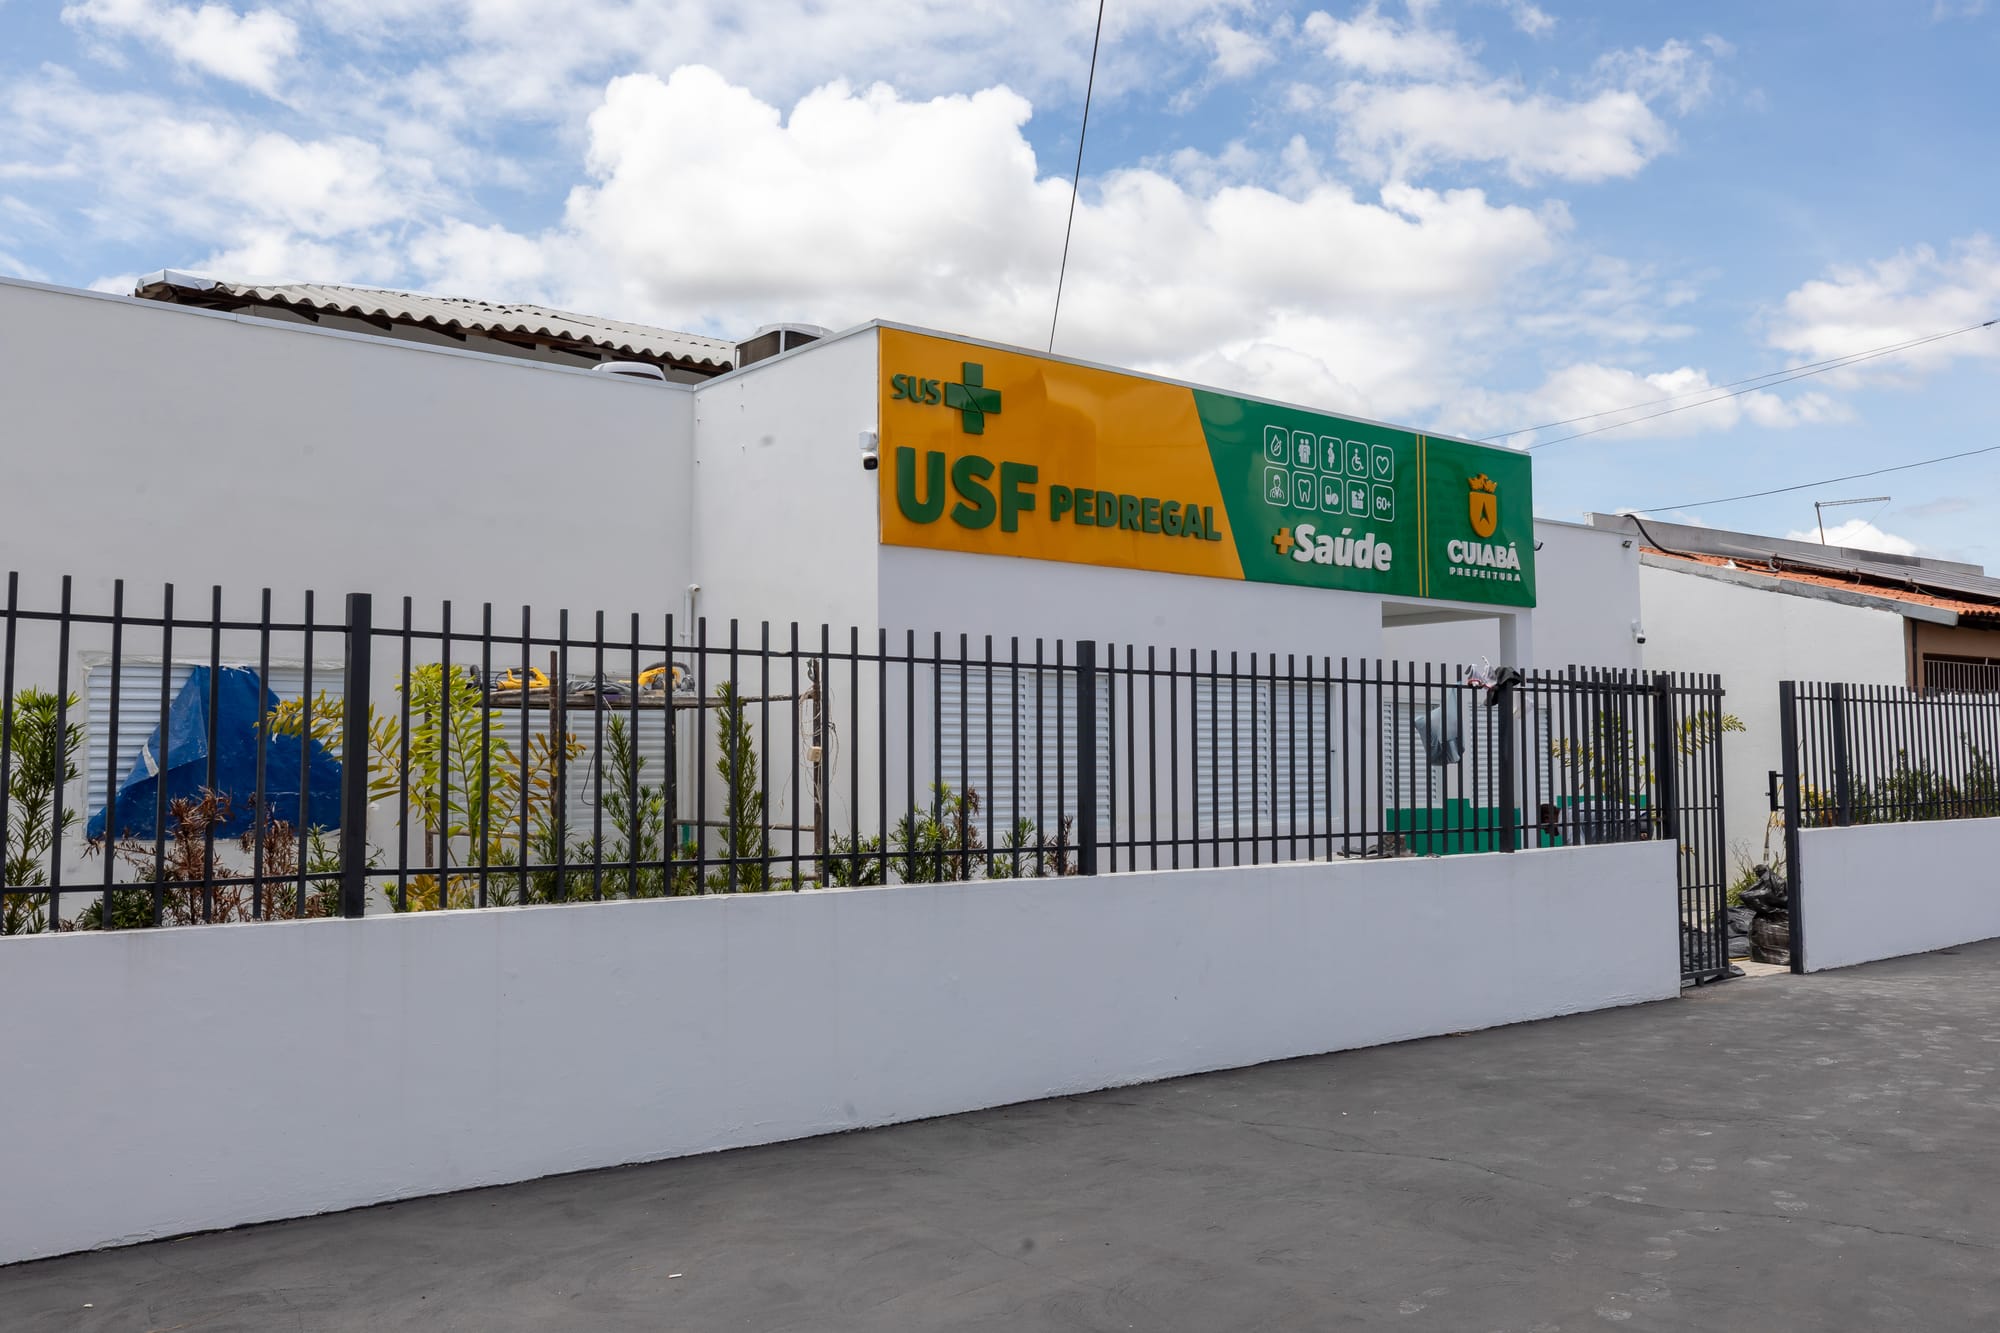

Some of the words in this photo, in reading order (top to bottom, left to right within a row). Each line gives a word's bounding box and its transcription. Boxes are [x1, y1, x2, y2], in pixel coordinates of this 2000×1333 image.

[892, 374, 941, 405] SUS
[896, 446, 1038, 533] USF
[1050, 485, 1222, 541] PEDREGAL
[1375, 496, 1391, 511] 60+
[1447, 540, 1520, 570] CUIABÁ
[1449, 567, 1521, 582] PREFEITURA
